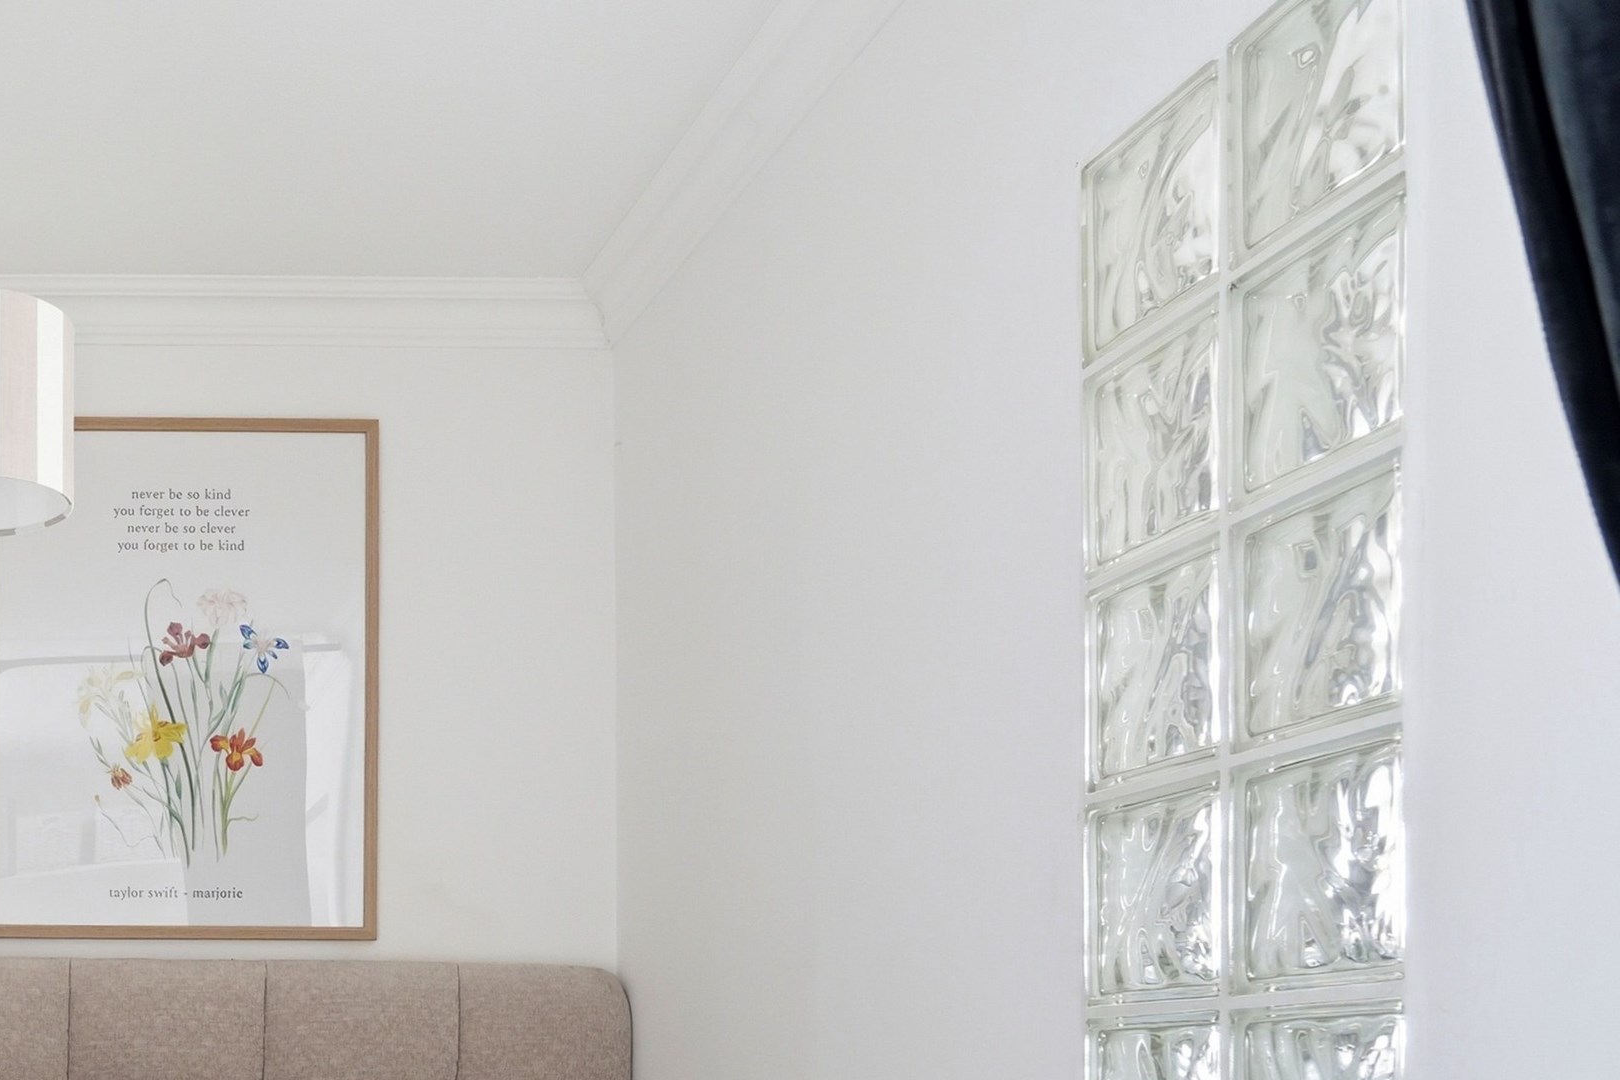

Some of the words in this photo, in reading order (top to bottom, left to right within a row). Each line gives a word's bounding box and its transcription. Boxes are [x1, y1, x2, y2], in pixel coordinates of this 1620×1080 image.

[132, 490, 165, 500] never
[169, 488, 183, 500] be
[187, 491, 200, 500] so
[205, 488, 232, 500] kind
[113, 507, 135, 519] you
[139, 505, 175, 519] forget
[179, 507, 192, 517] to
[196, 505, 210, 517] be
[214, 505, 251, 517] clever
[127, 525, 160, 534] never
[165, 522, 179, 534] be
[182, 525, 196, 534] so
[200, 522, 236, 534] clever
[117, 542, 139, 553] you
[143, 539, 179, 553] forget
[183, 542, 195, 551] to
[200, 539, 214, 551] be
[218, 539, 245, 551] kind
[109, 886, 144, 900] taylor
[147, 886, 179, 899] swift
[192, 887, 244, 901] marjorie
